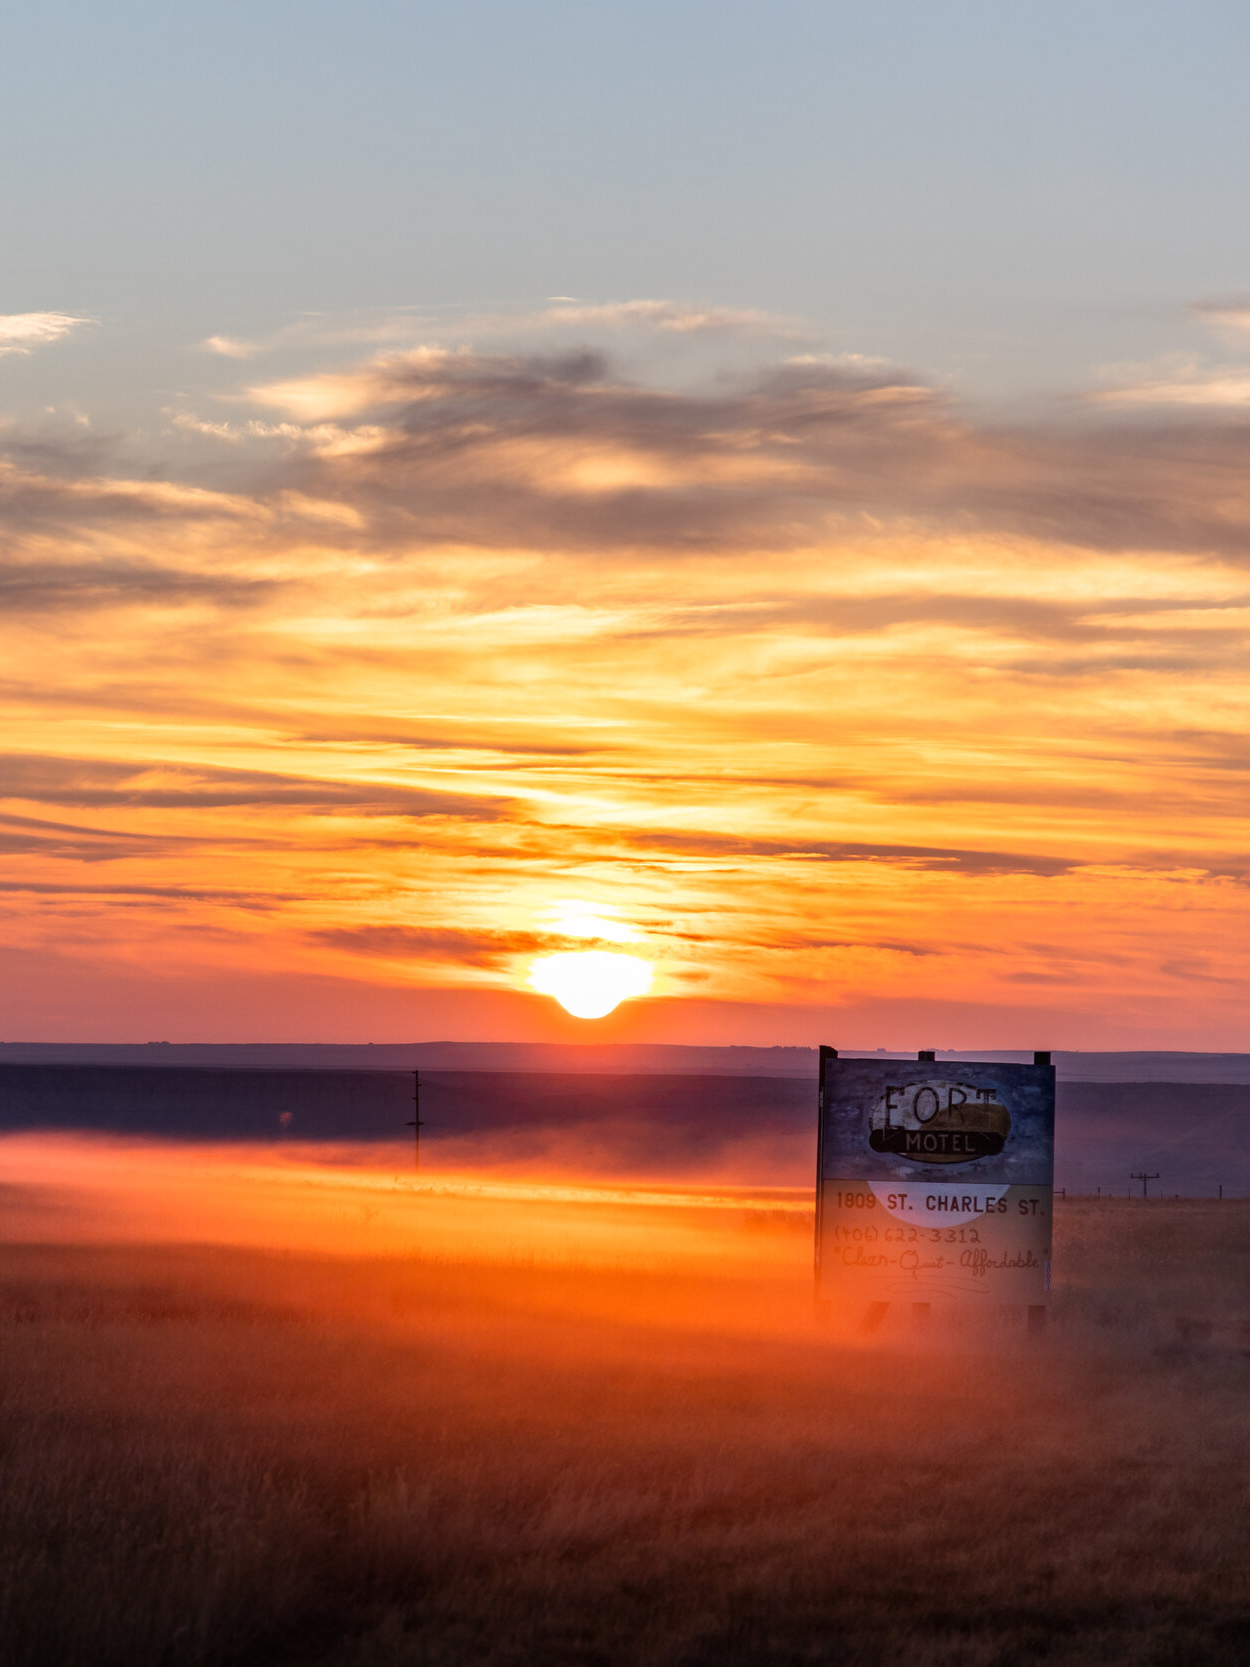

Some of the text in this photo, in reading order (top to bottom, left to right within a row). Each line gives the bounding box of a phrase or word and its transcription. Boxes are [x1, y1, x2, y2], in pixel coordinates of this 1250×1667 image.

[885, 1085, 997, 1129] FORT
[905, 1133, 976, 1152] MOTEL
[837, 1191, 1045, 1216] 1809 ST. CHARLES ST.
[834, 1225, 982, 1244] (406) 622-3312
